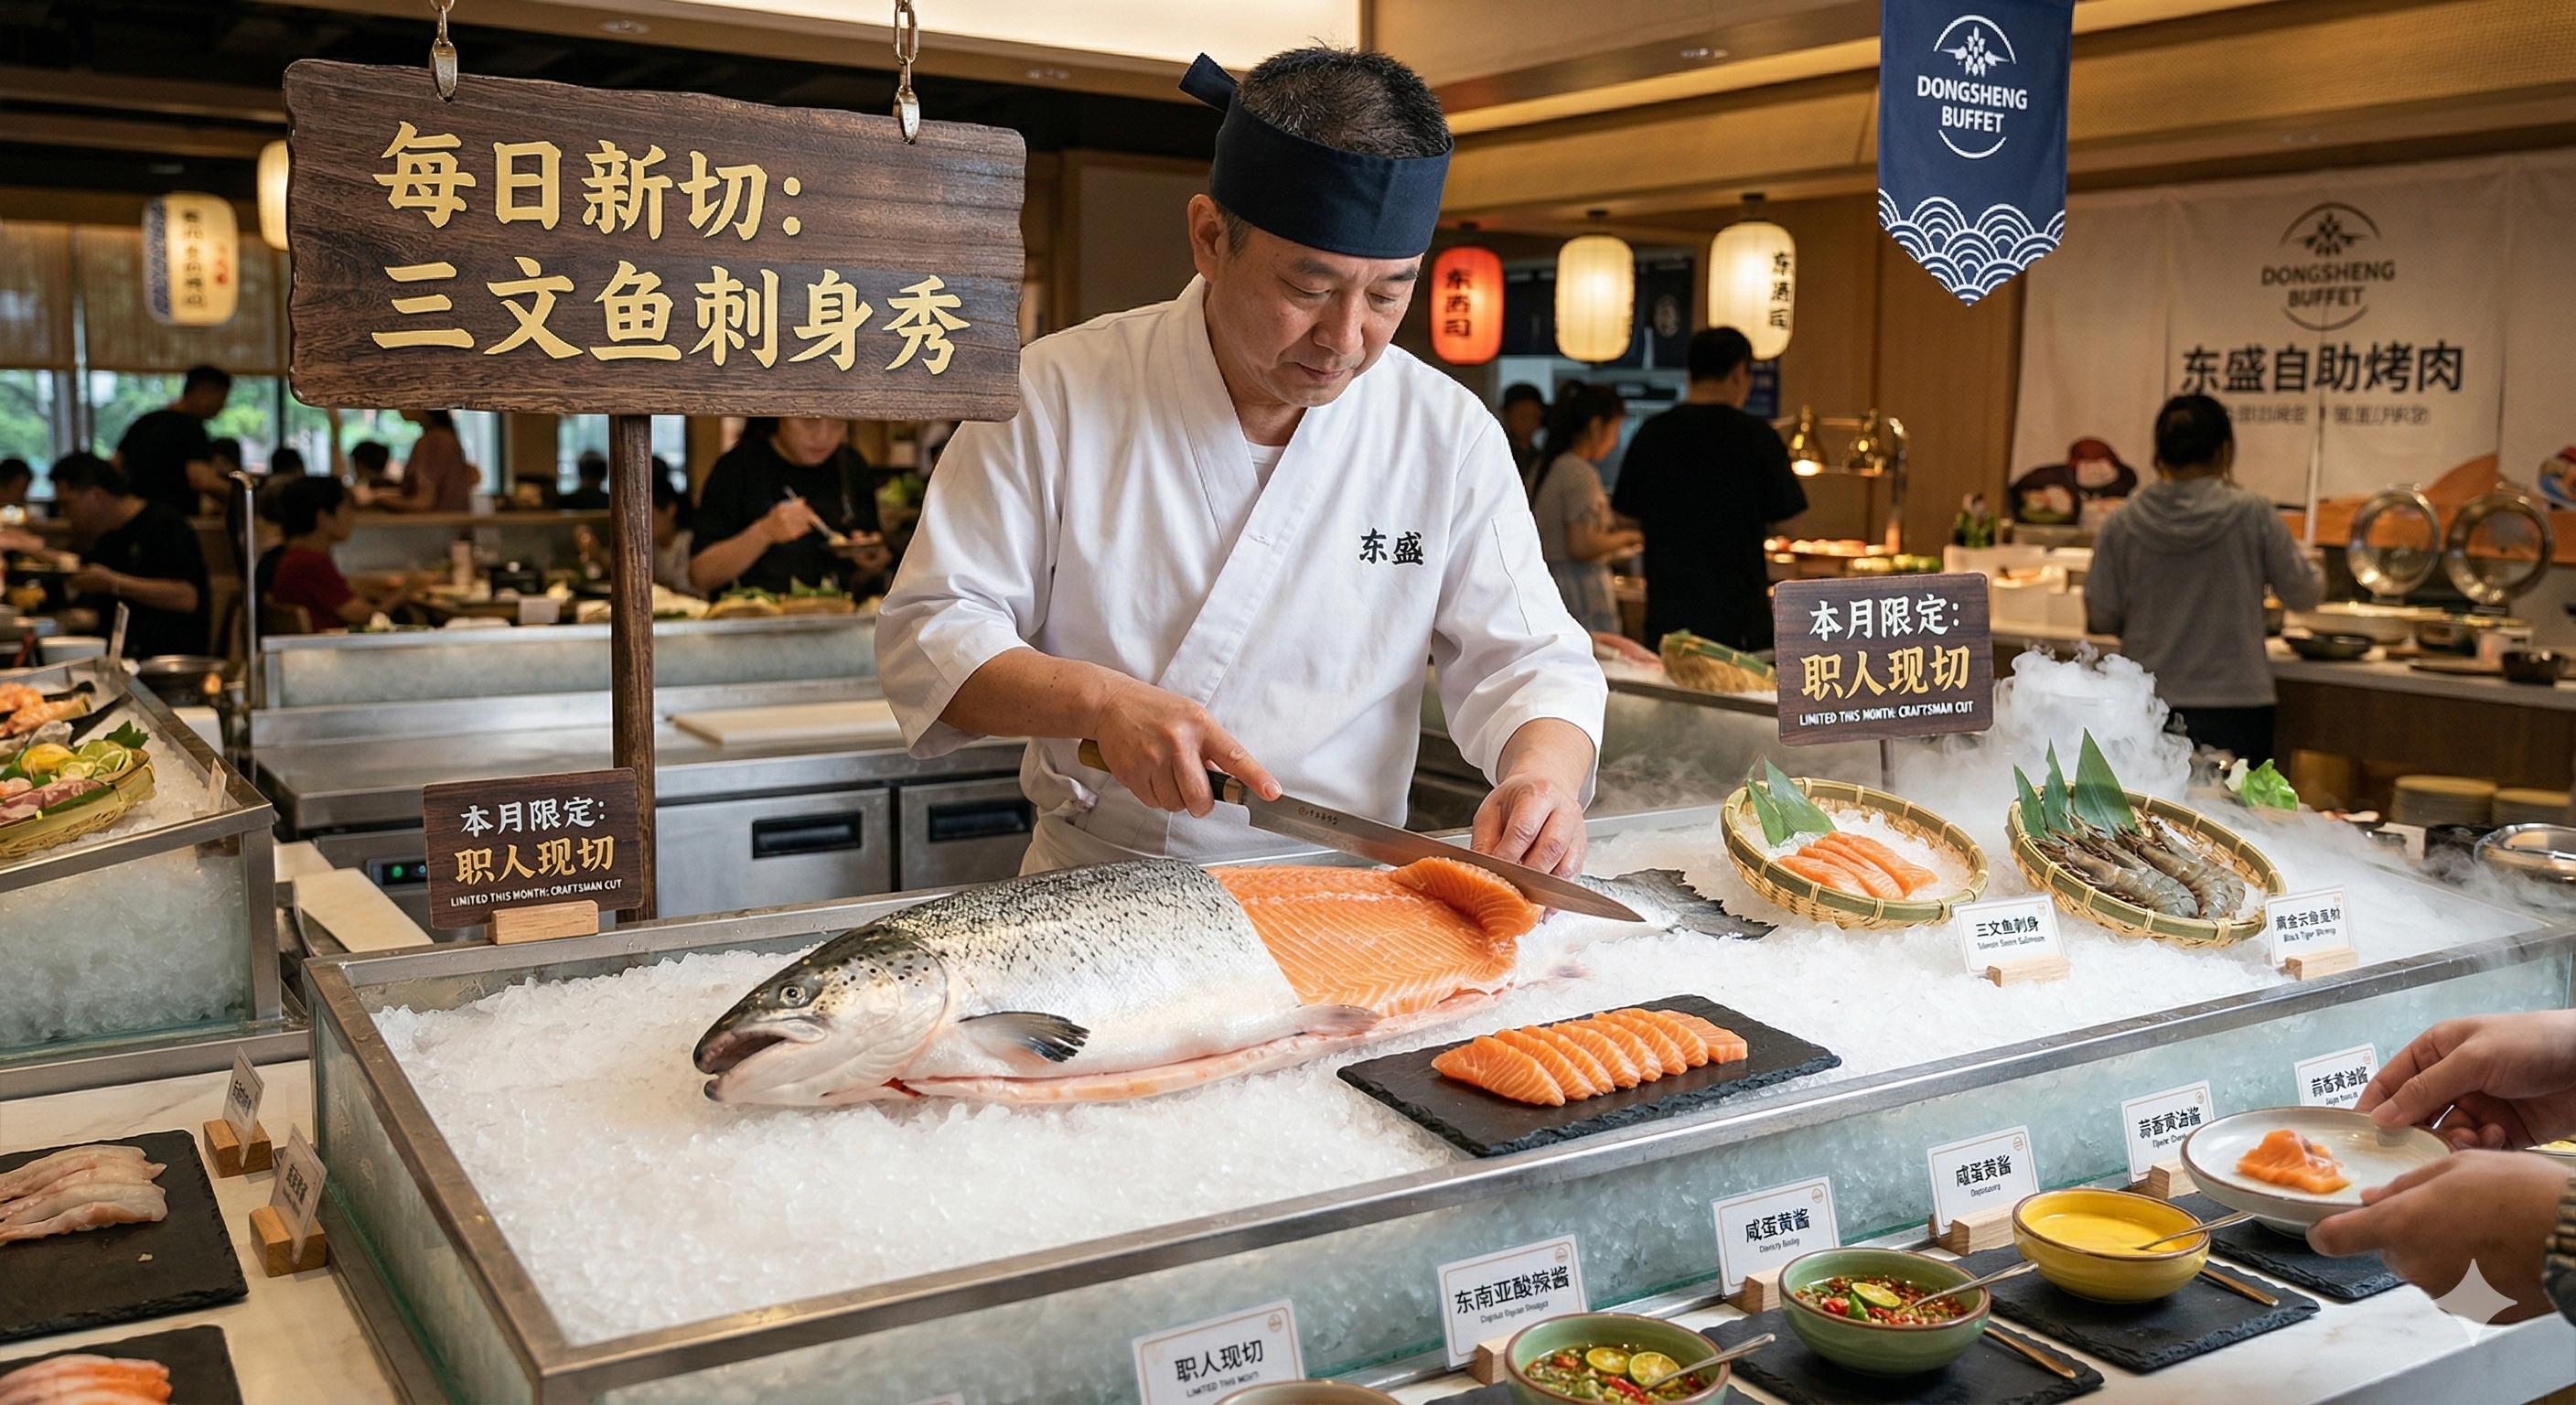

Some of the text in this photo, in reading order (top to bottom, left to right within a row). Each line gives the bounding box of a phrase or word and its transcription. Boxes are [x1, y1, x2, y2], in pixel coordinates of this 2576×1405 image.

[1917, 75, 2028, 110] DONGSHENG
[1941, 105, 2004, 134] BUFFET
[2260, 260, 2396, 287] DONGSHENG
[2288, 285, 2367, 308] BUFFET
[371, 256, 971, 375] 三文鱼刺身秀
[2181, 339, 2464, 393] 东盛自助烤肉
[1358, 527, 1424, 565] 东盛
[1799, 645, 1970, 702] 职人现切
[1955, 700, 1974, 713] CUT
[454, 835, 615, 885] 职人现切
[550, 881, 603, 896] CRAFTSMAN
[604, 879, 622, 890] CUT
[1745, 1207, 1810, 1243] 咸蛋黄酱
[1454, 1265, 1570, 1314] 东南亚酸辣酱
[1175, 1339, 1264, 1383] 职人现切
